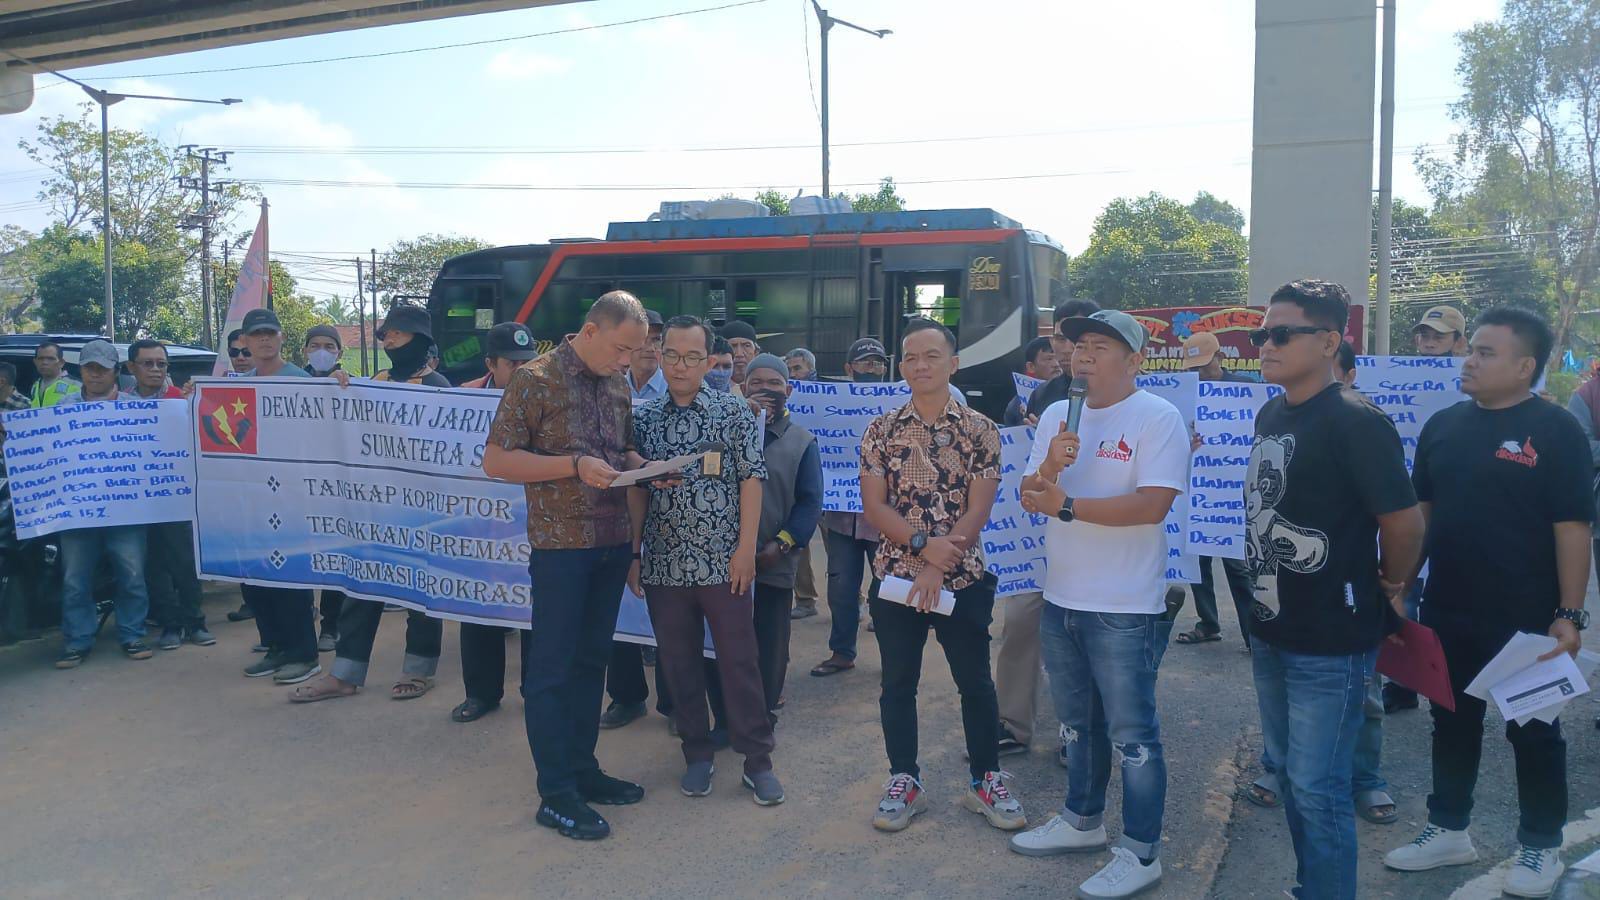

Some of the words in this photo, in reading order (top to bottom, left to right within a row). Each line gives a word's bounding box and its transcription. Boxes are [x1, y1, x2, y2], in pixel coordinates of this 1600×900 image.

[1190, 311, 1265, 332] SUKSE
[849, 383, 912, 397] KEJAKS
[1199, 382, 1253, 398] DANA
[1379, 380, 1446, 392] SEGERA
[262, 392, 325, 419] DEWAN
[331, 397, 427, 427] PIMPINAN
[1197, 405, 1254, 421] BOLEH
[5, 446, 45, 459] DANA
[110, 432, 160, 442] UNTUK
[360, 433, 465, 467] SUMATERA
[9, 455, 69, 476] ANGGOTA
[150, 449, 190, 458] YANG
[62, 481, 97, 493] DESA
[150, 475, 186, 486] BATU
[304, 478, 397, 504] TANGKAP
[402, 487, 513, 521] KORUPTOR
[306, 515, 409, 547] TEGAKKAN
[1189, 530, 1233, 546] DESA
[312, 552, 412, 587] REFORMASI
